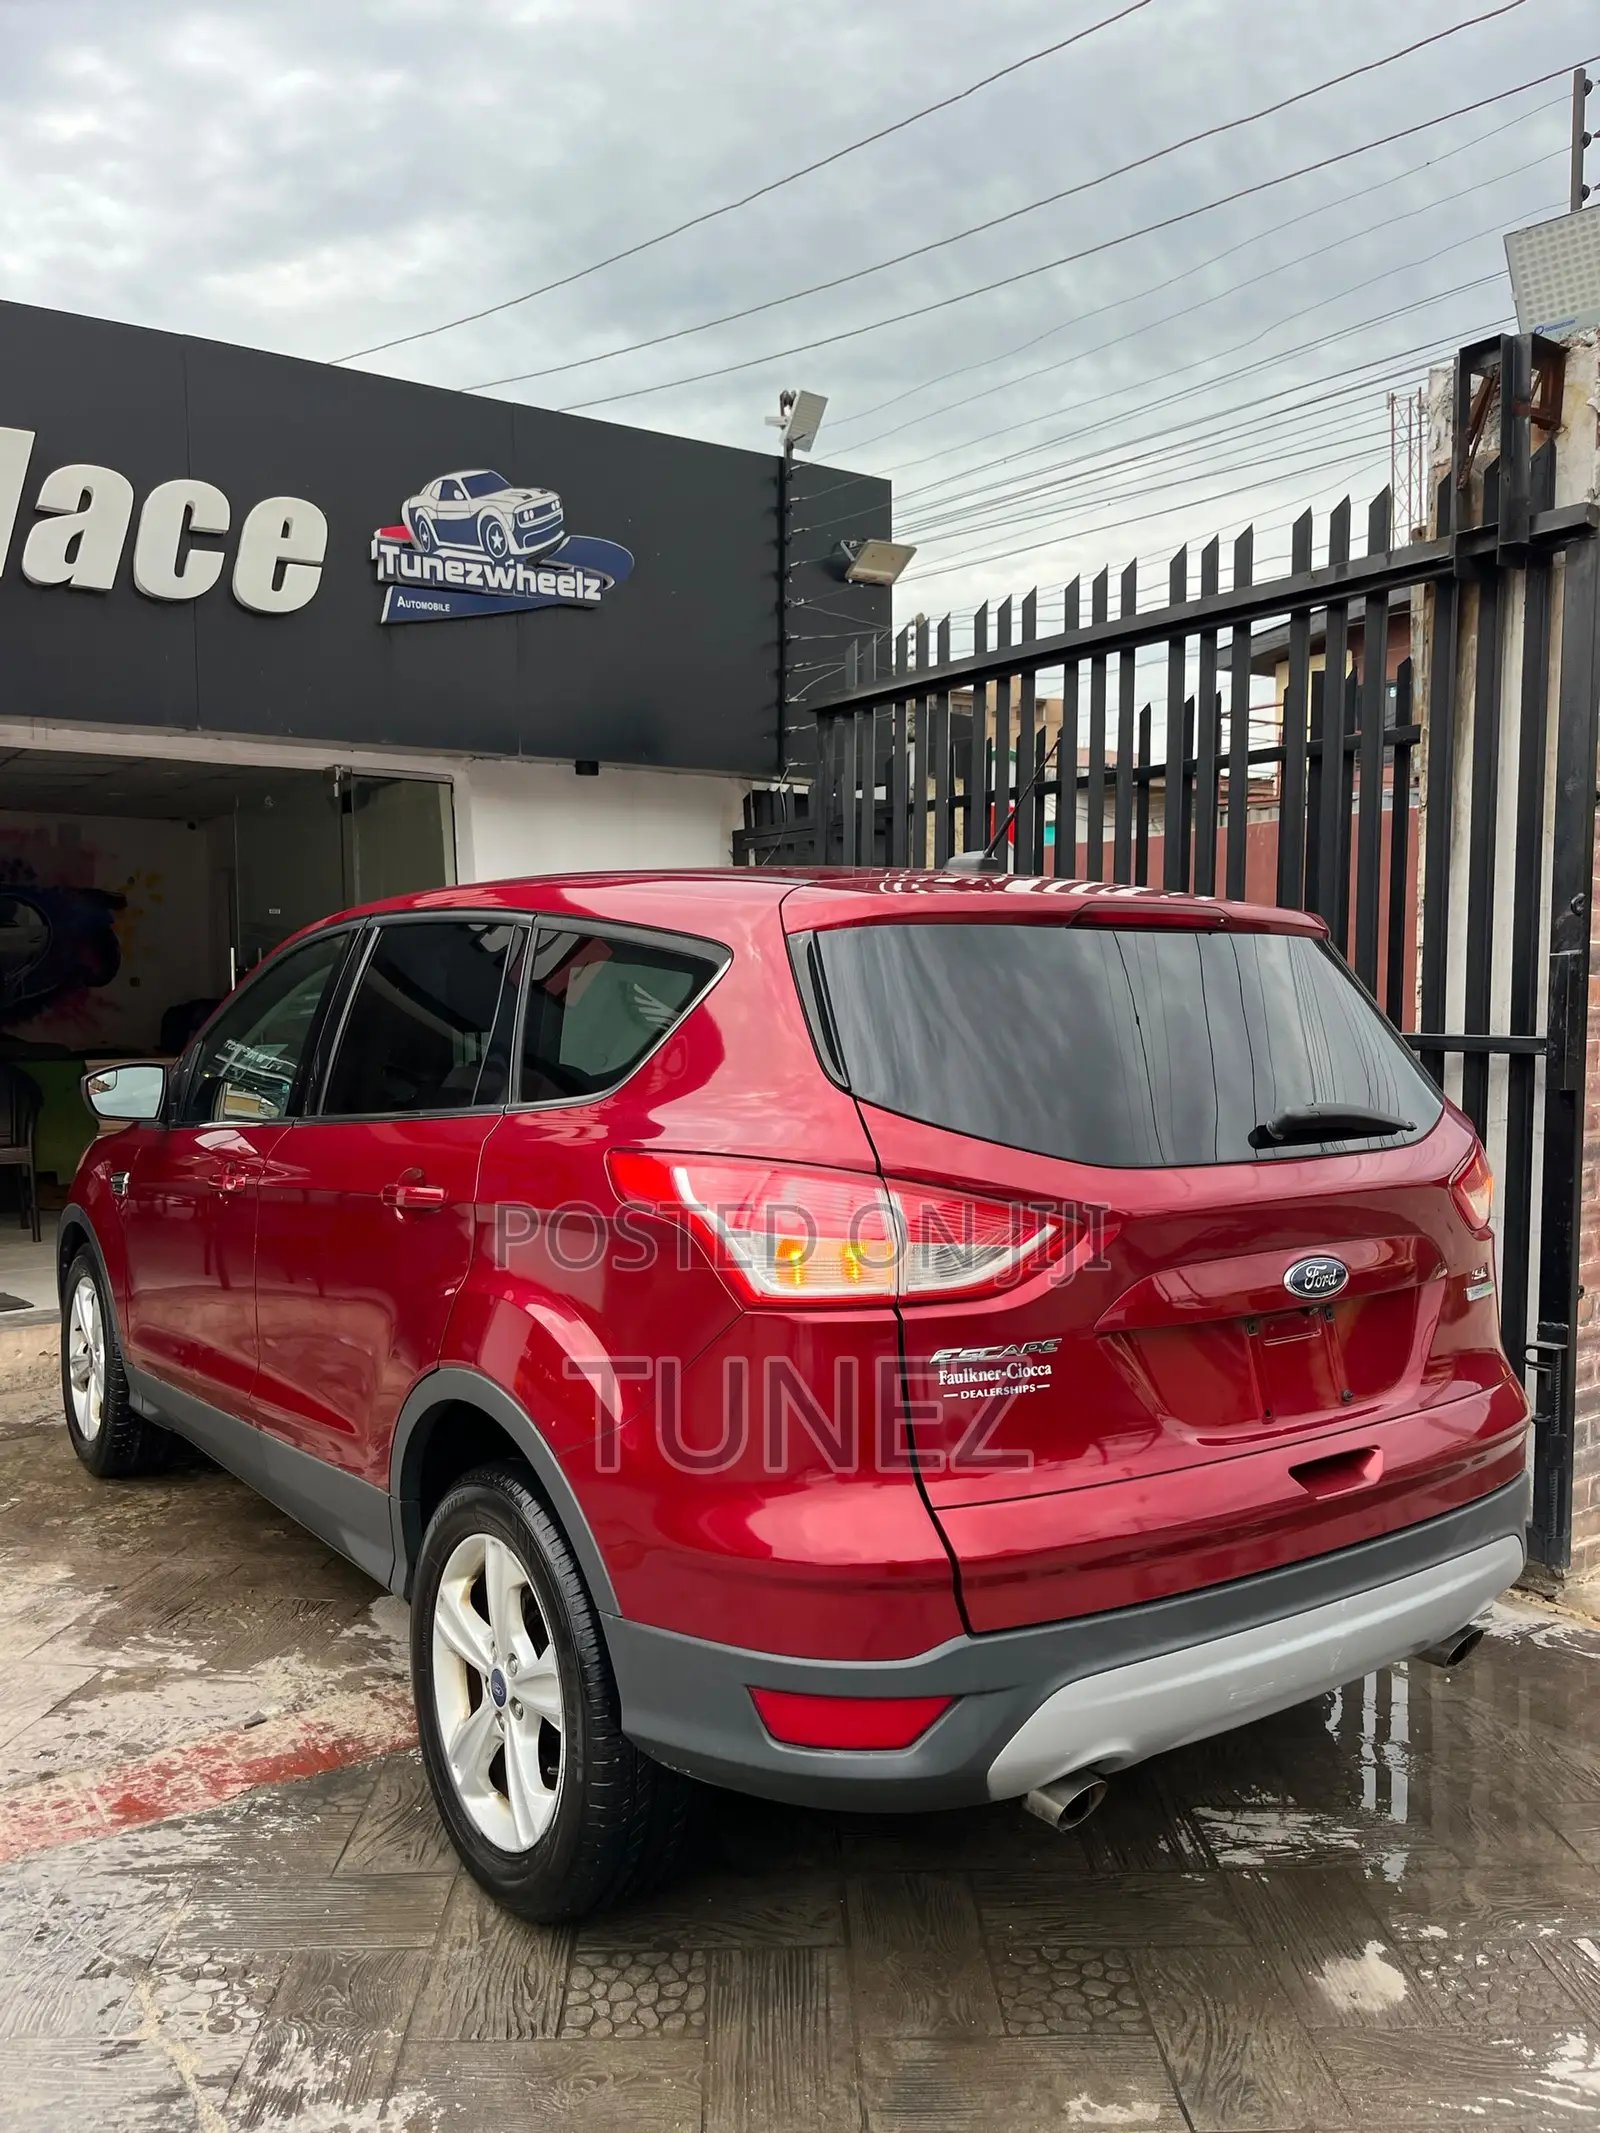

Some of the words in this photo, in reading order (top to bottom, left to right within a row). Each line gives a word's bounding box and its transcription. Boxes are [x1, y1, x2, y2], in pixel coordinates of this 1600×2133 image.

[380, 544, 602, 600] Tunezwheelz
[1304, 1265, 1337, 1290] Ford
[929, 1338, 1062, 1364] ESCAPE
[938, 1362, 1052, 1385] Faulkner-Ciocca
[960, 1384, 1036, 1399] DEALERSHIPS
